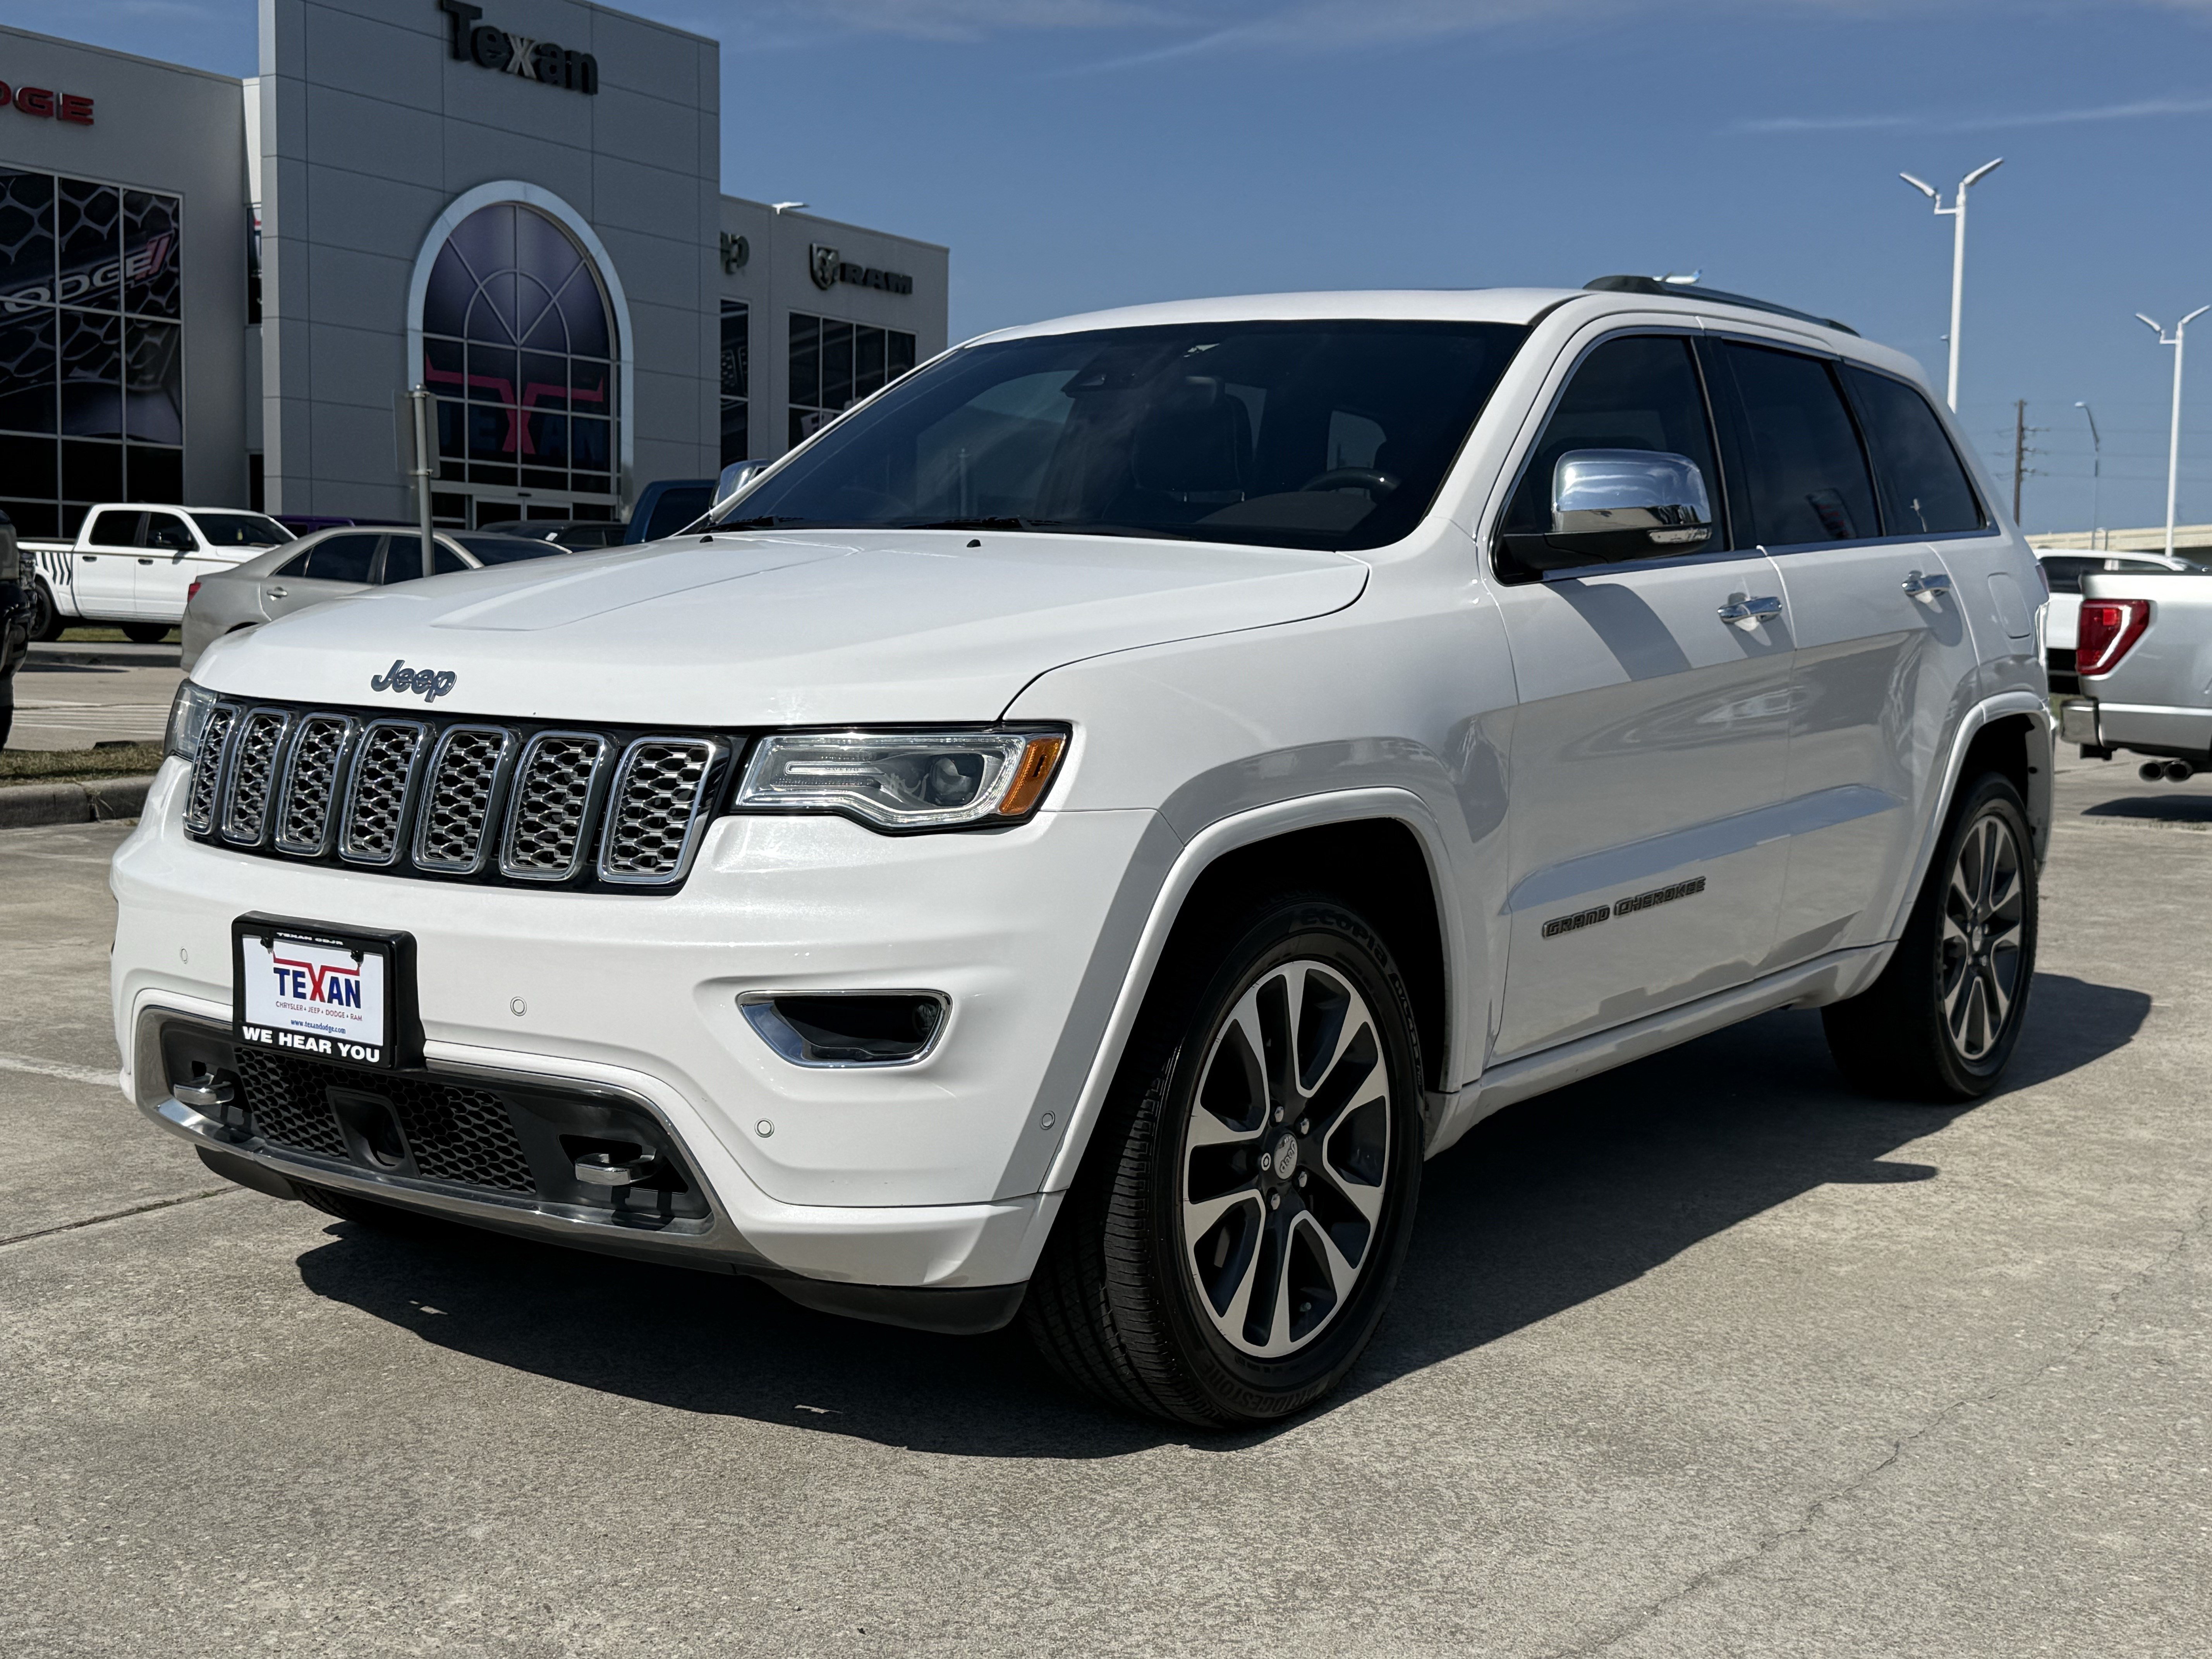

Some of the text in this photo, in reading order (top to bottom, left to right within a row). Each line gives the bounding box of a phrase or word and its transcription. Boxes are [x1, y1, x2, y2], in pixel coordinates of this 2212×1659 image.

[440, 0, 598, 95] Texan
[840, 262, 912, 294] RAM
[371, 659, 457, 703] Jeep
[1542, 876, 1706, 938] GRAND CHEROKEE
[273, 951, 361, 1009] TEXAN
[276, 1001, 303, 1011] CHRYSLER
[308, 1006, 320, 1014] JEEP
[326, 1009, 345, 1018] DODGE
[291, 1019, 346, 1034] www.texandodge.com
[242, 1026, 380, 1063] WE HEAR YOU
[1279, 1140, 1295, 1173] Jeep
